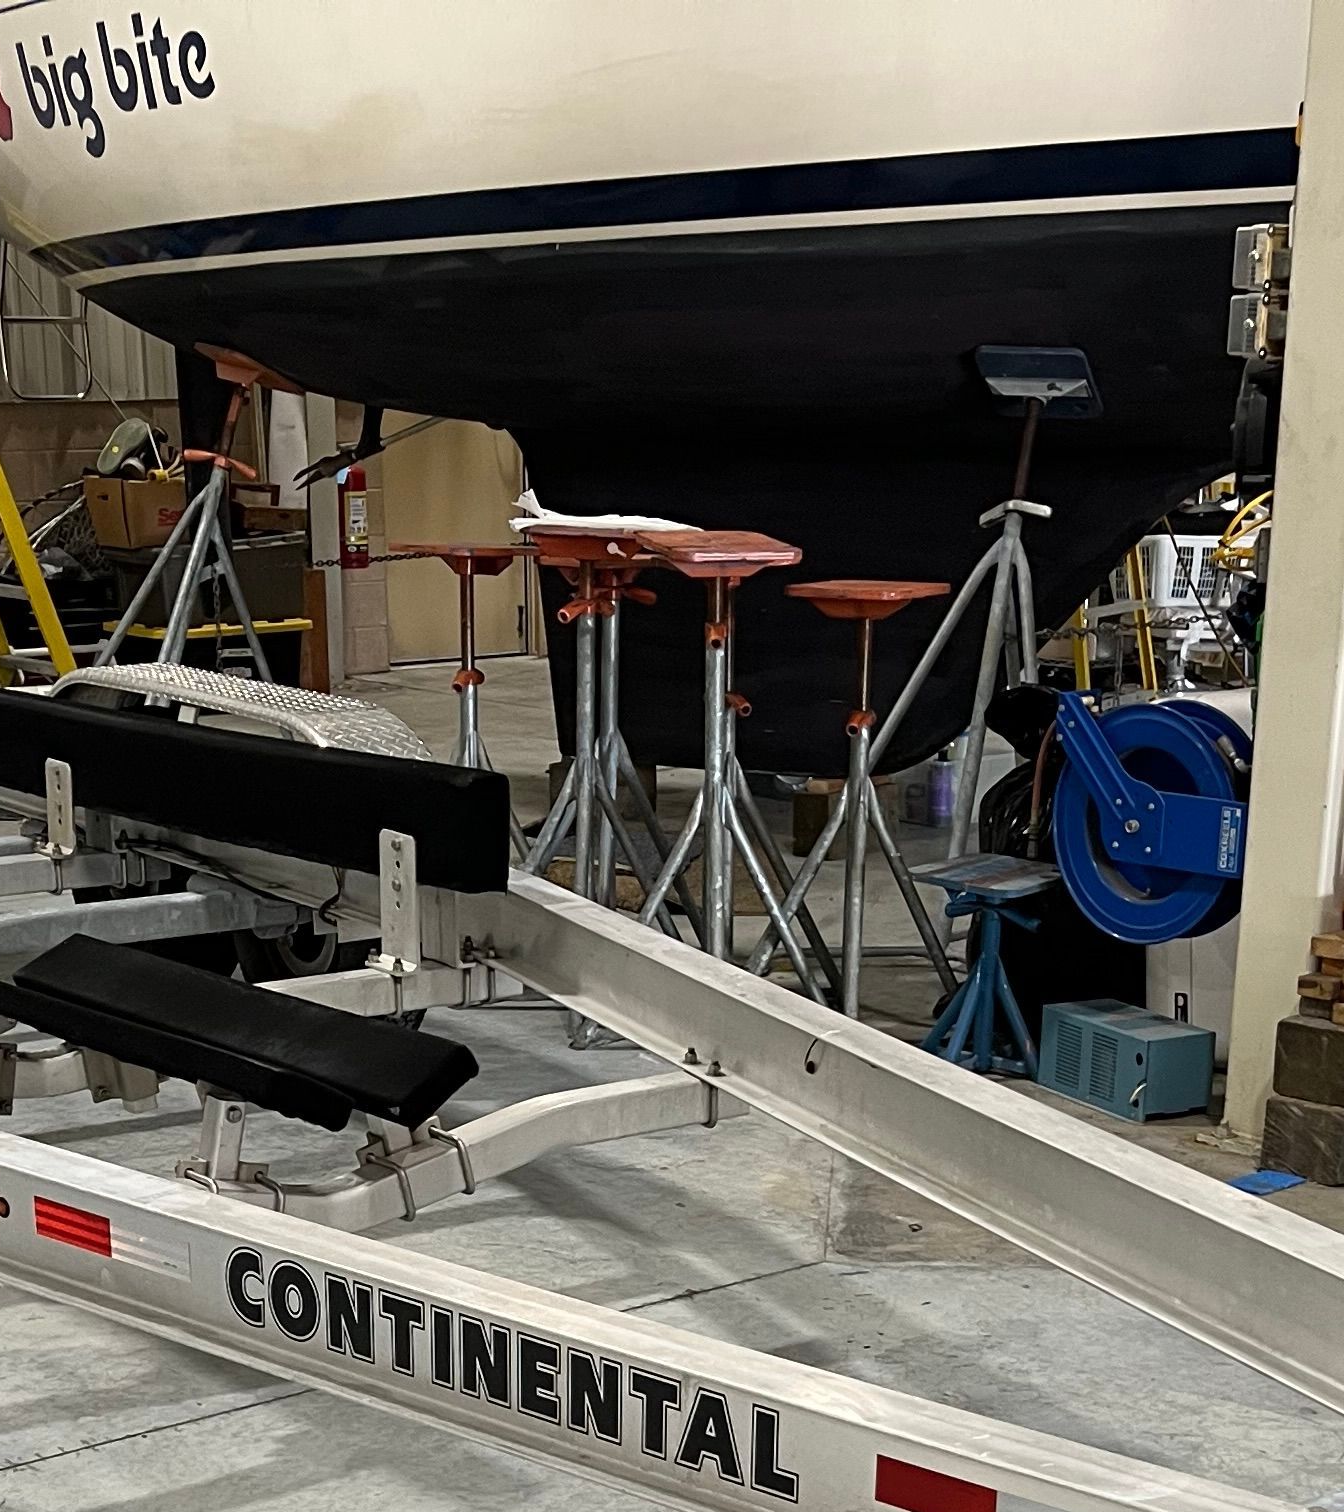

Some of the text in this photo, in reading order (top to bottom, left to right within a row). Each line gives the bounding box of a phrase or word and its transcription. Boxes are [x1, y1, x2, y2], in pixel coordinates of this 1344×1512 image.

[16, 12, 216, 158] big bite
[225, 1246, 800, 1504] CONTINENTAL
